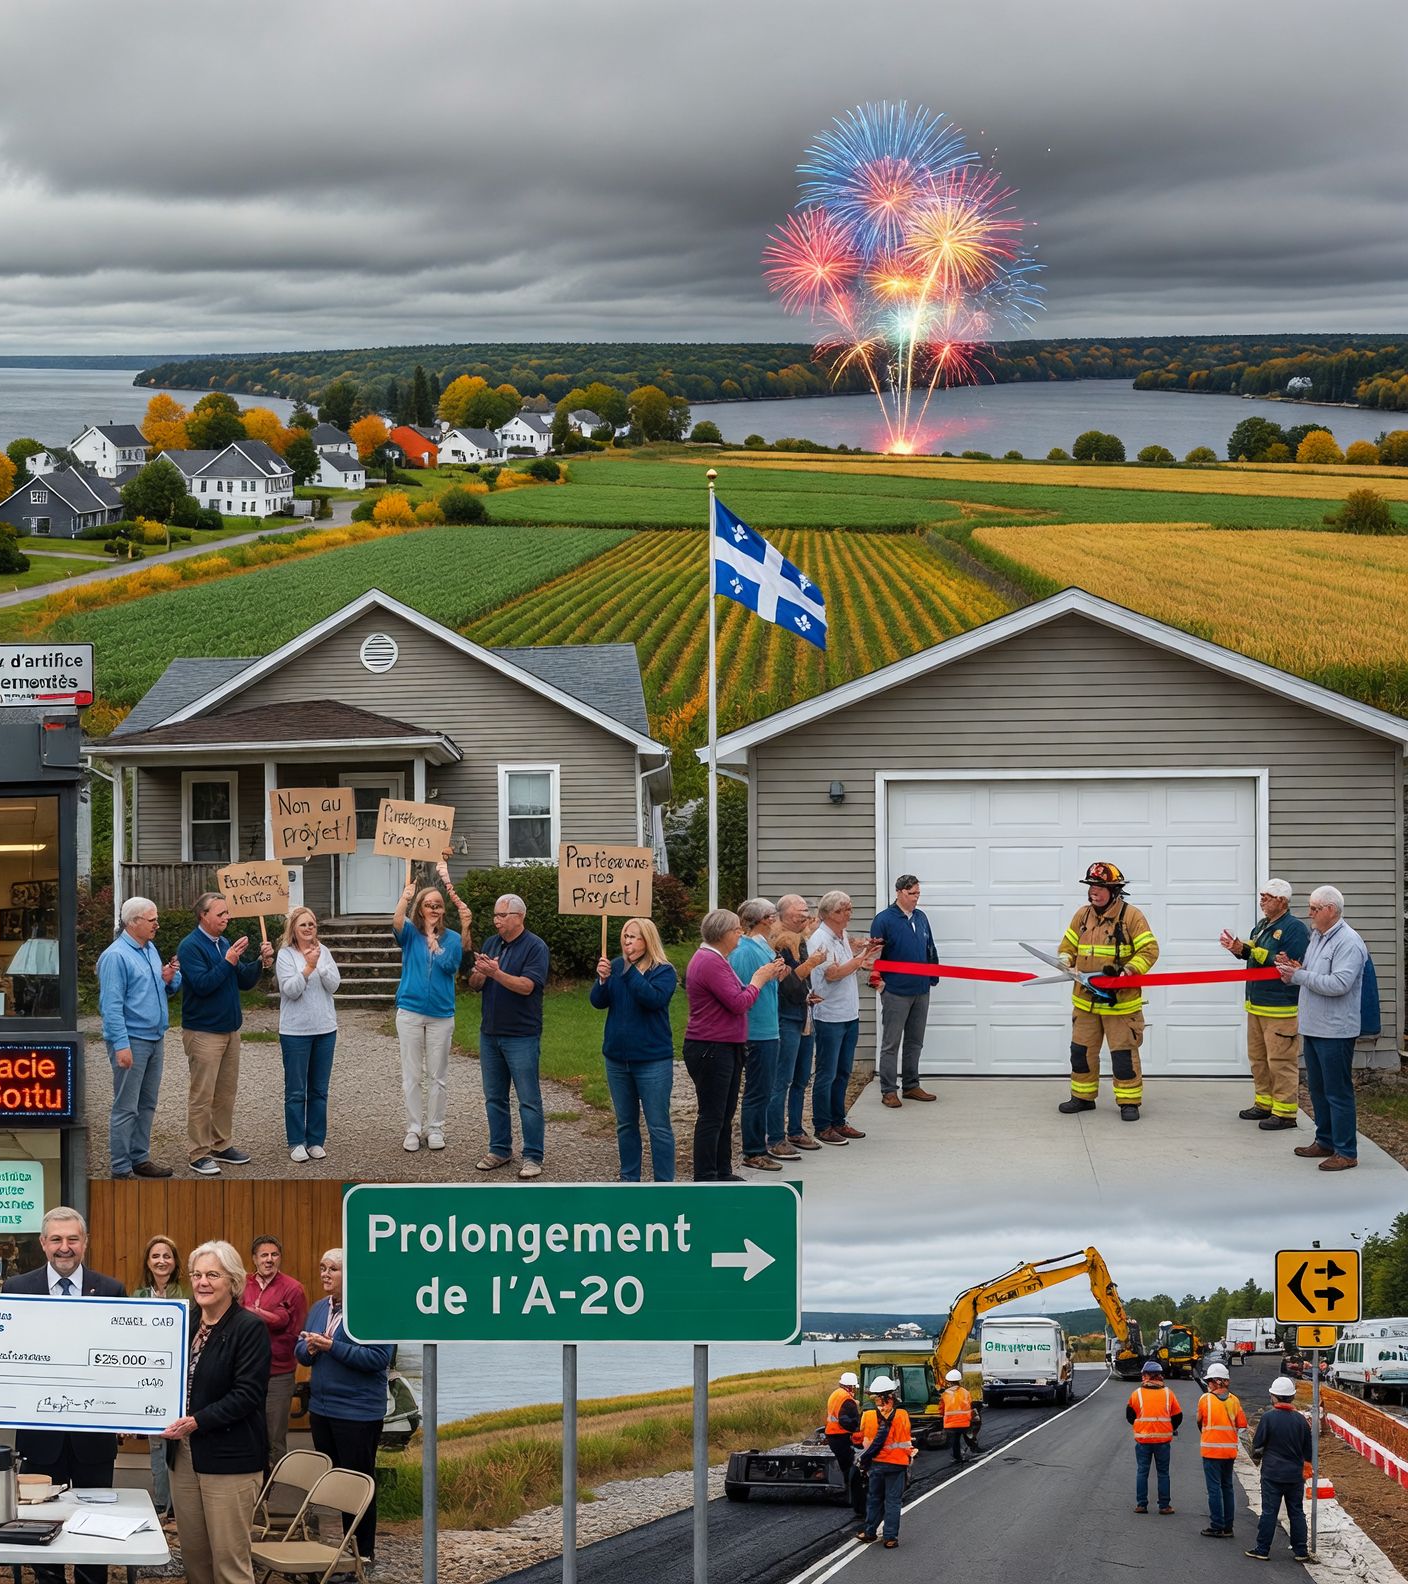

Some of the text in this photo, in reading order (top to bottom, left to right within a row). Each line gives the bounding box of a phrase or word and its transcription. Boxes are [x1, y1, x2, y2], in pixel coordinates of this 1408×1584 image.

[10, 652, 84, 668] d'artifice
[277, 791, 341, 816] Non au
[367, 1213, 692, 1264] Prolongement
[415, 1275, 645, 1315] de l'A-20
